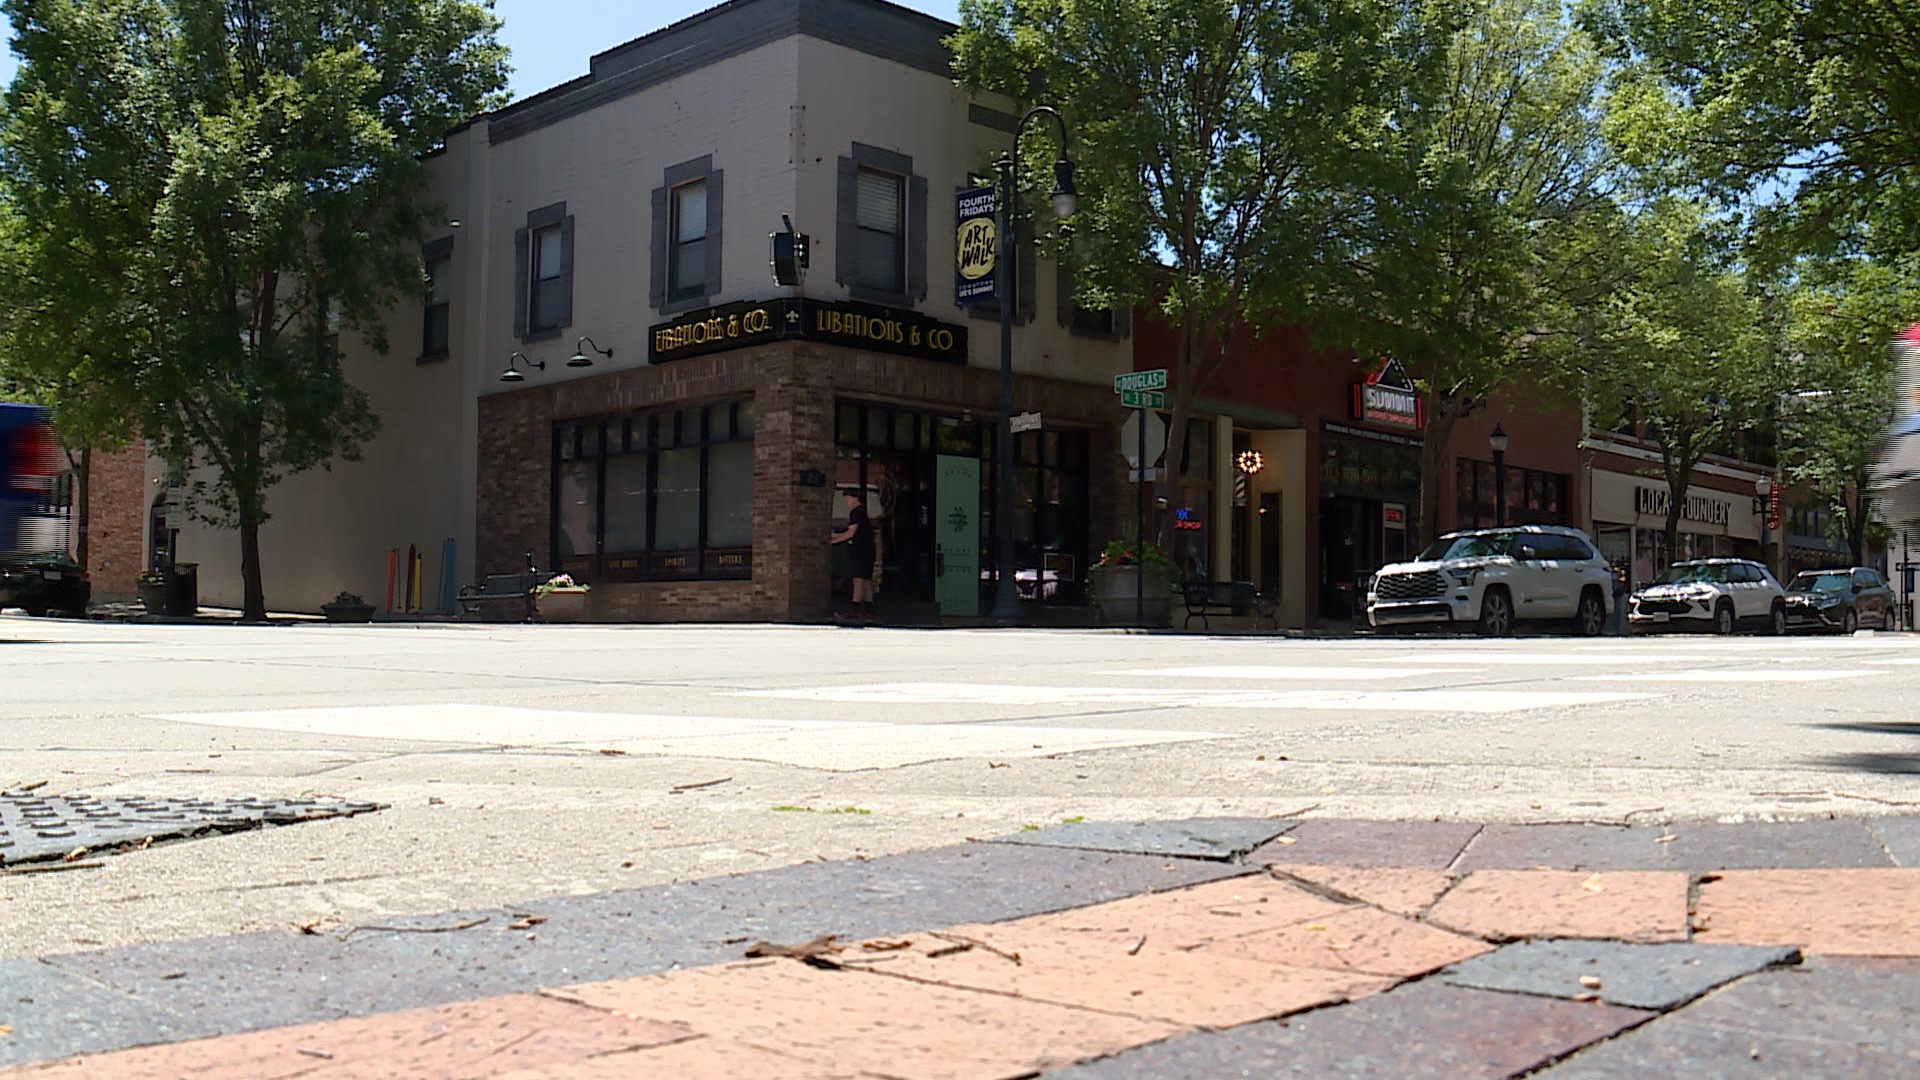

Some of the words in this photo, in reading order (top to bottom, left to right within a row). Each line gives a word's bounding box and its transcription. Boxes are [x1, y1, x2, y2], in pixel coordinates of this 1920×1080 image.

[959, 193, 995, 209] FOURTH
[959, 203, 994, 218] FRIDAYS
[964, 225, 989, 248] ART
[961, 237, 995, 269] WALK
[655, 316, 724, 353] LIBATIONS
[726, 313, 740, 338] &
[816, 308, 904, 344] LIBATIONS
[909, 325, 921, 346] &
[1121, 372, 1159, 390] DOUGLAS
[1366, 388, 1415, 414] SUMMIT
[1637, 486, 1671, 516] LOCA
[1680, 495, 1733, 527] FOUNDERY
